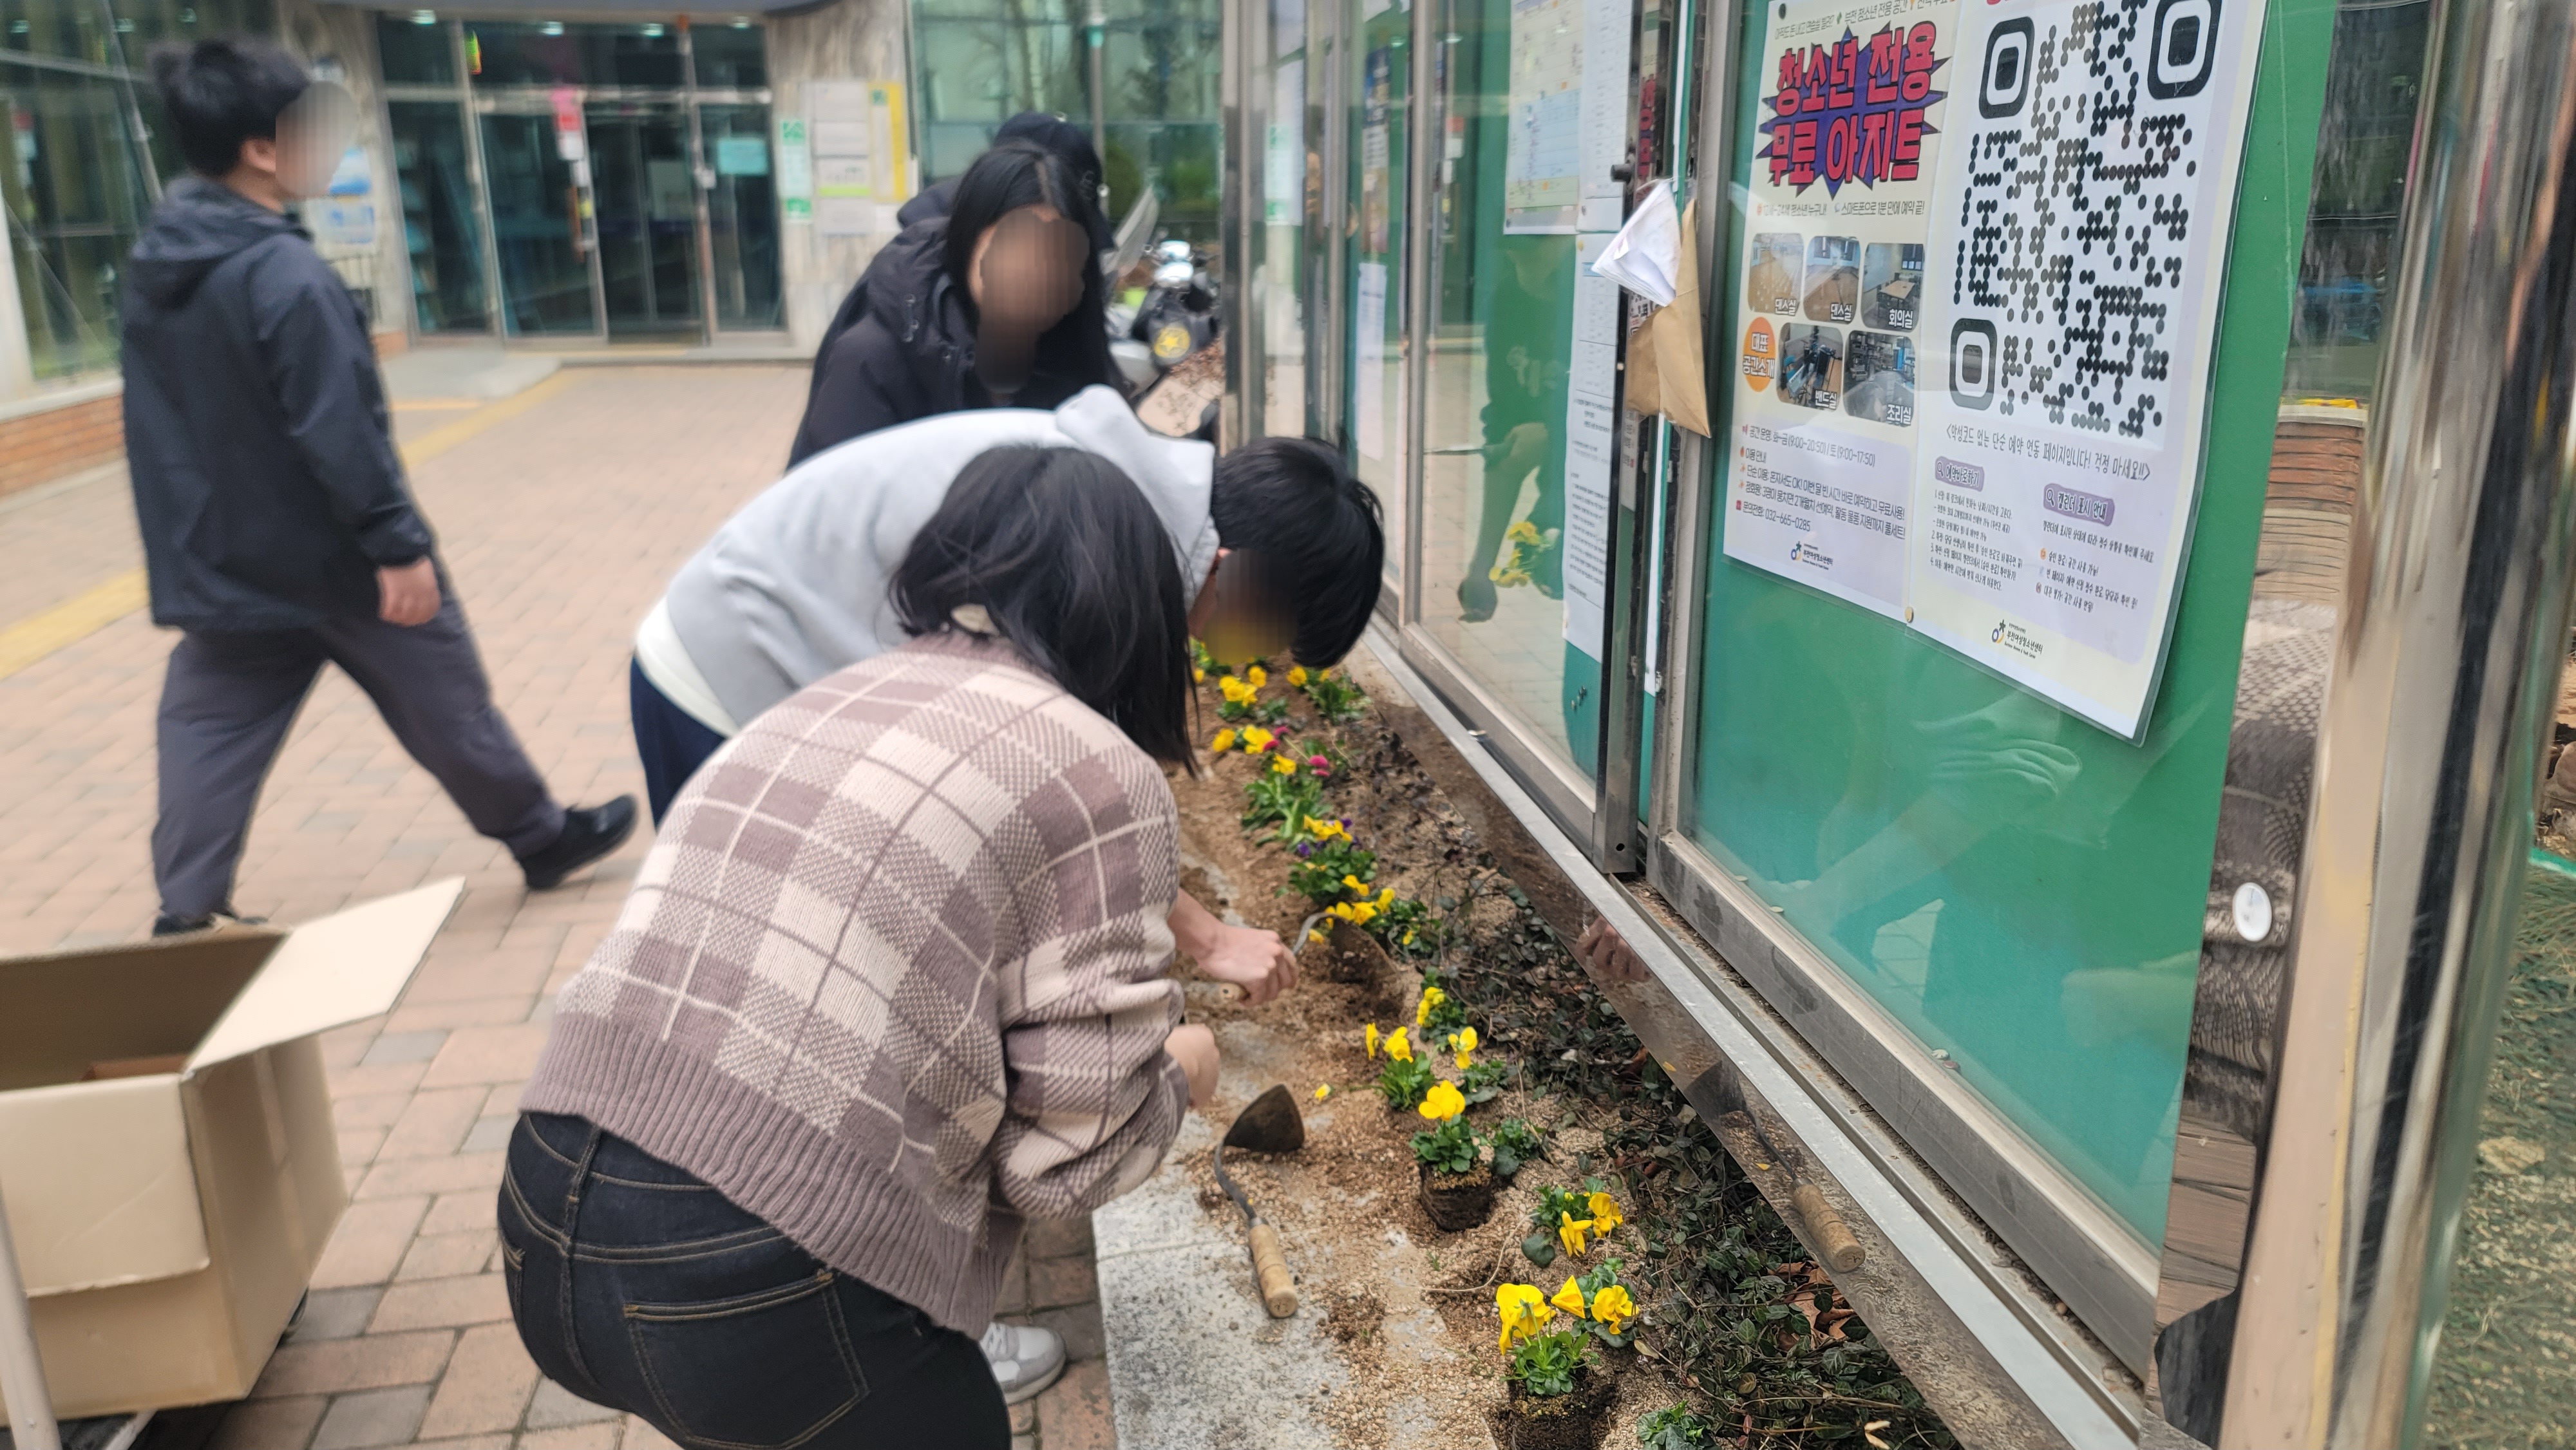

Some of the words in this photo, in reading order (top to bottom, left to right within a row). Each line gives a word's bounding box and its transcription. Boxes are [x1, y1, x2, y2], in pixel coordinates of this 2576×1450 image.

[1858, 5, 1877, 23] 청소년
[1878, 2, 1893, 18] 전용
[1776, 36, 1859, 117] 청소년
[1866, 21, 1937, 104] 전용
[1769, 120, 1818, 187] 무료
[1826, 108, 1925, 183] 아지트
[1841, 202, 1877, 216] 스마트폰으로
[1877, 202, 1887, 215] 1분
[1888, 201, 1900, 215] 만에
[1901, 201, 1915, 215] 예약
[1915, 200, 1925, 215] 끝!
[1775, 297, 1797, 316] 댄스실
[1830, 303, 1853, 322] 댄스실
[1888, 308, 1913, 329] 회의실
[1751, 332, 1769, 353] 대표
[1743, 355, 1776, 379] 공간소개
[1815, 389, 1837, 410] 밴드실
[1886, 404, 1912, 426] 조리실
[1750, 425, 1759, 439] 공간
[1830, 445, 1837, 457] 토
[1977, 429, 1989, 448] 없는
[1993, 433, 2006, 451] 단순
[2009, 436, 2023, 455] 예약
[2027, 439, 2040, 458] 연동
[2043, 442, 2091, 469] 페이지입니다!
[2095, 453, 2110, 473] 걱정
[1745, 447, 1756, 460] 이용
[1756, 451, 1766, 464] 안내
[1946, 464, 1979, 486] 예약바로하기
[1747, 464, 1757, 478] 단순
[1770, 471, 1792, 487] 혼자서도
[1792, 477, 1803, 489] OK!
[1803, 480, 1815, 494] 이번
[1815, 482, 1821, 495] 달
[1822, 484, 1828, 497] 빈
[1828, 486, 1841, 501] 시간
[1841, 491, 1853, 505] 바로
[1853, 493, 1877, 512] 예약하고
[1762, 486, 1776, 500] 3명이
[1777, 490, 1794, 505] 뭉치면
[1794, 494, 1815, 511] 2개월치
[1835, 506, 1846, 521] 활동
[1847, 510, 1859, 525] 물품
[1860, 514, 1884, 533] 지원까지
[1884, 521, 1905, 540] 풀세트!
[2058, 493, 2076, 512] 캘린더
[2078, 498, 2091, 516] 표시
[2093, 502, 2107, 520] 안내
[1765, 509, 1810, 532] 032-665-0285
[2060, 525, 2072, 538] 표시된
[2073, 529, 2087, 543] 상태에
[2087, 534, 2098, 546] 따라
[2049, 551, 2056, 563] 승인
[2077, 561, 2086, 573] 사용
[2007, 630, 2043, 654] 부천여성청소년센터
